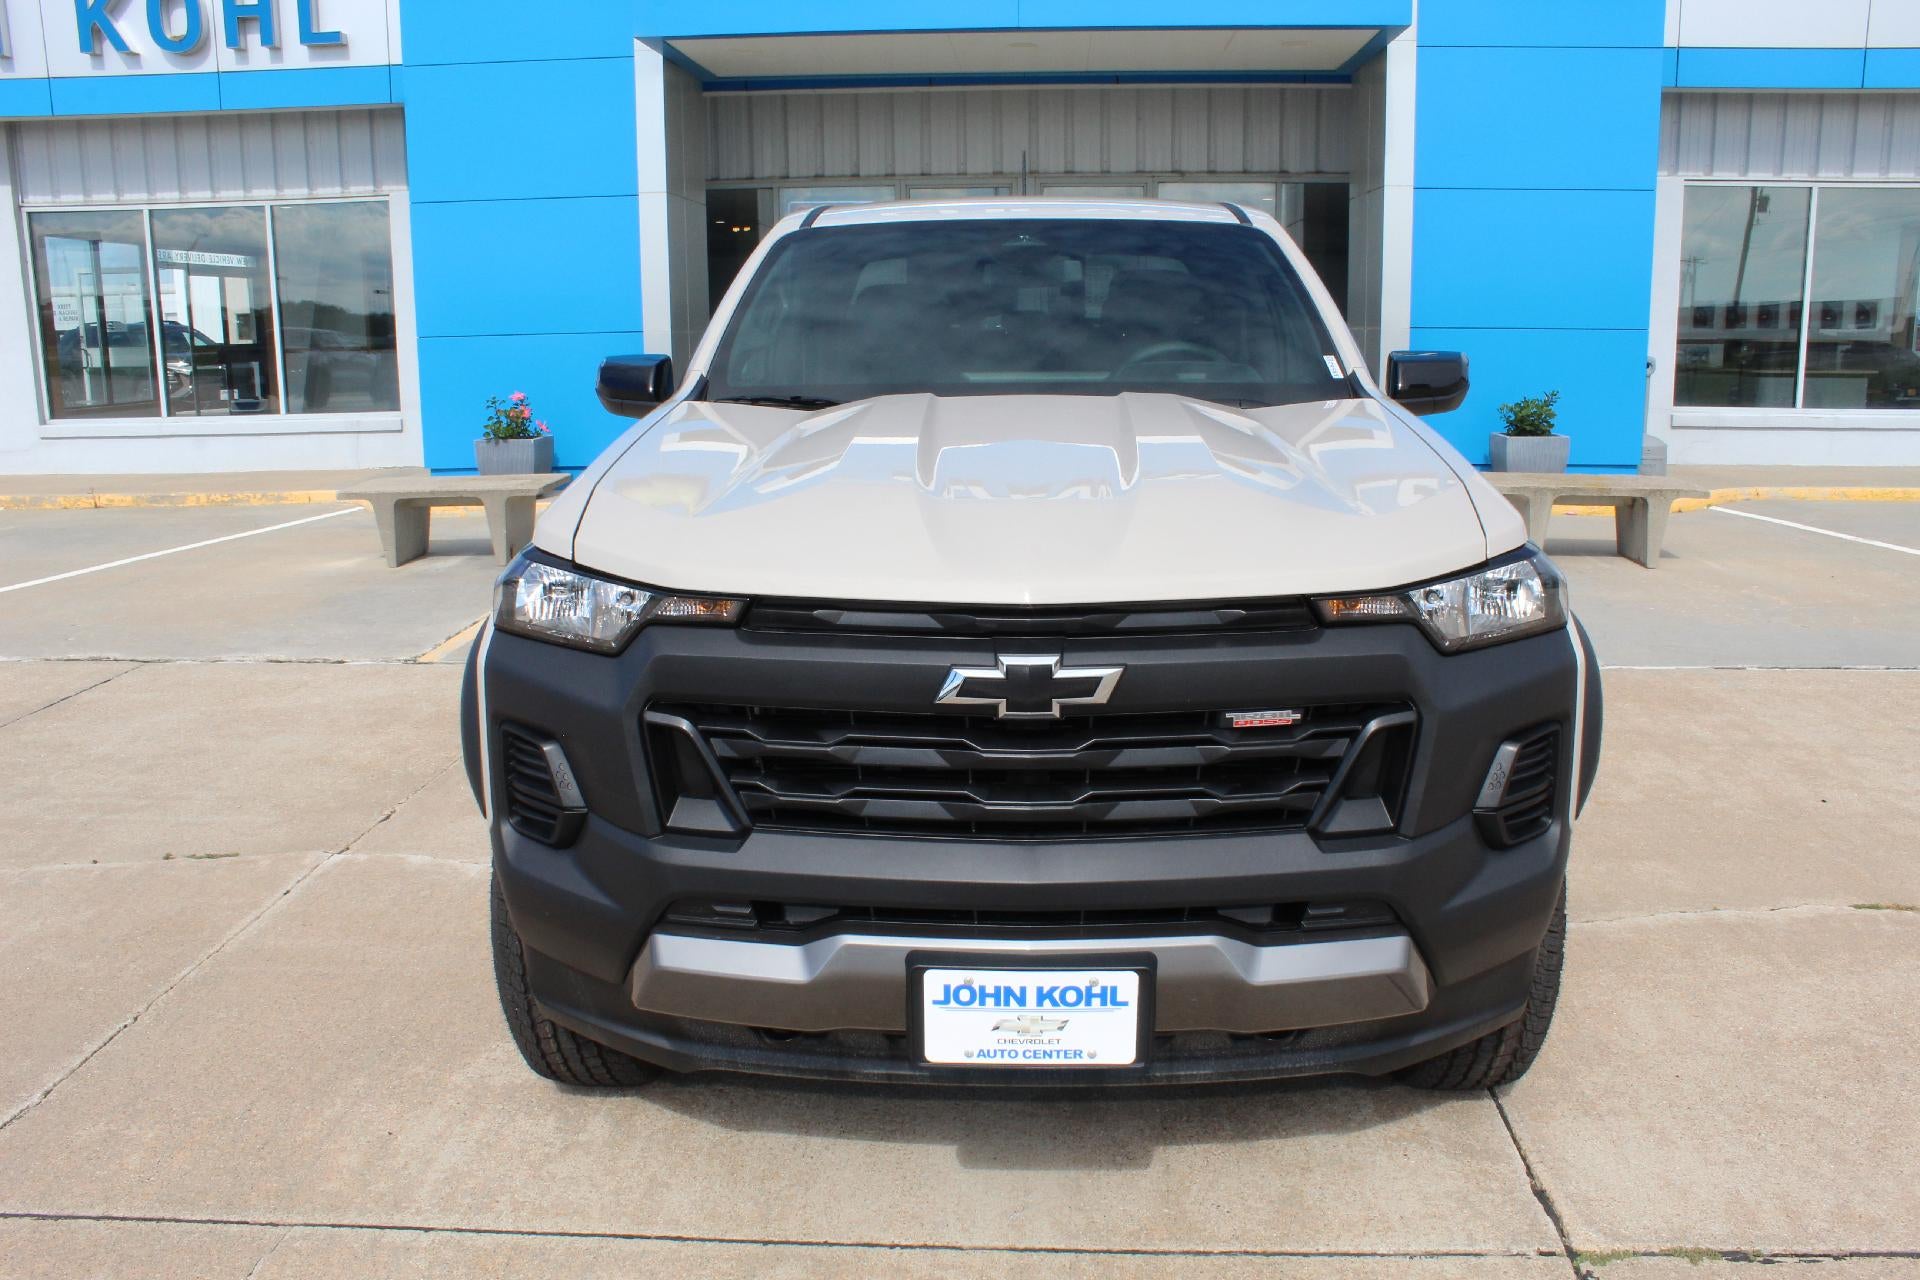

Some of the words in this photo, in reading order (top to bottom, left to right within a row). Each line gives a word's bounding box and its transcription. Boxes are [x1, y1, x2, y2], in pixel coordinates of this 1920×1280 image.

[76, 0, 347, 54] KOHL
[1233, 718, 1292, 727] BOSS
[932, 984, 1027, 1008] JOHN
[1035, 986, 1129, 1008] KOHL
[976, 1048, 1019, 1060] AUTO
[1022, 1049, 1084, 1060] CENTER
